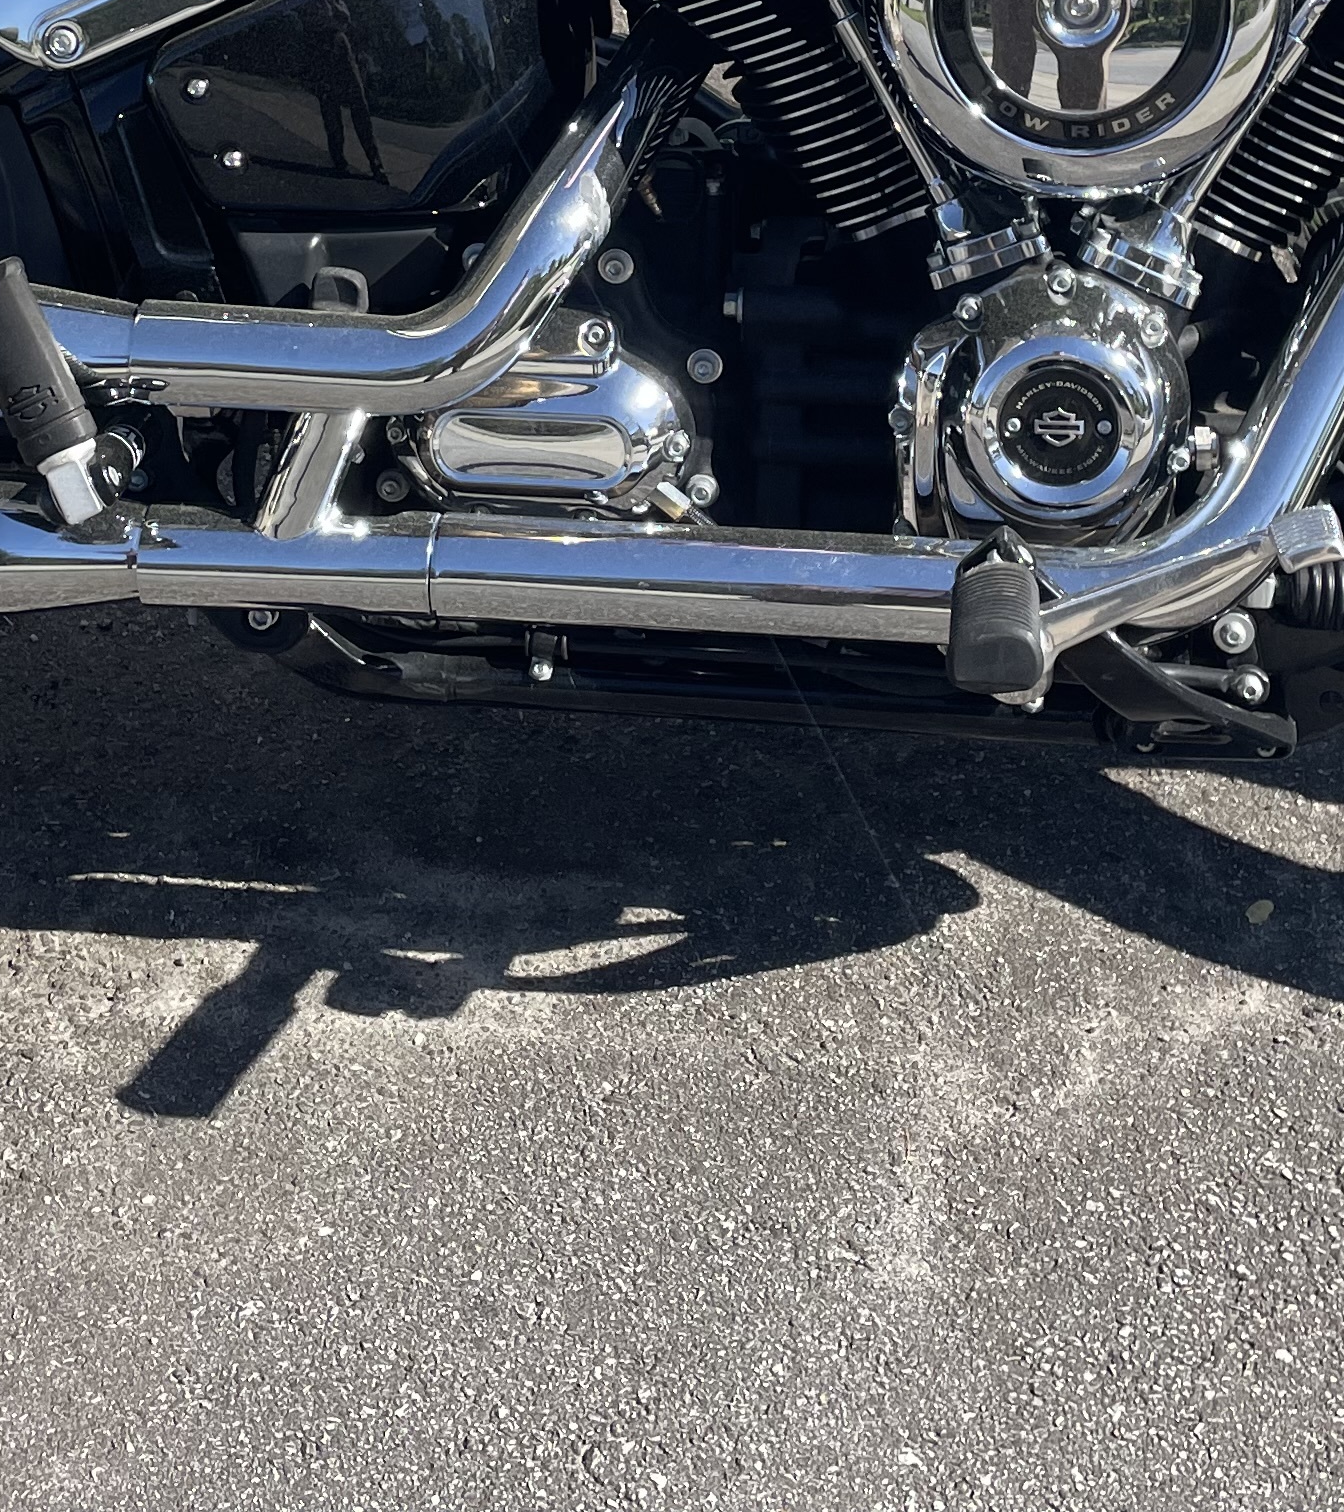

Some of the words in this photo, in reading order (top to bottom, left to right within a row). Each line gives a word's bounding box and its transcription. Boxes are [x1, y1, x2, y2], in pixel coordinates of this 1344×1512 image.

[982, 88, 1050, 133] LOW
[1070, 90, 1178, 139] RIDER
[1015, 379, 1104, 412] HARLEY-DAVIDSON
